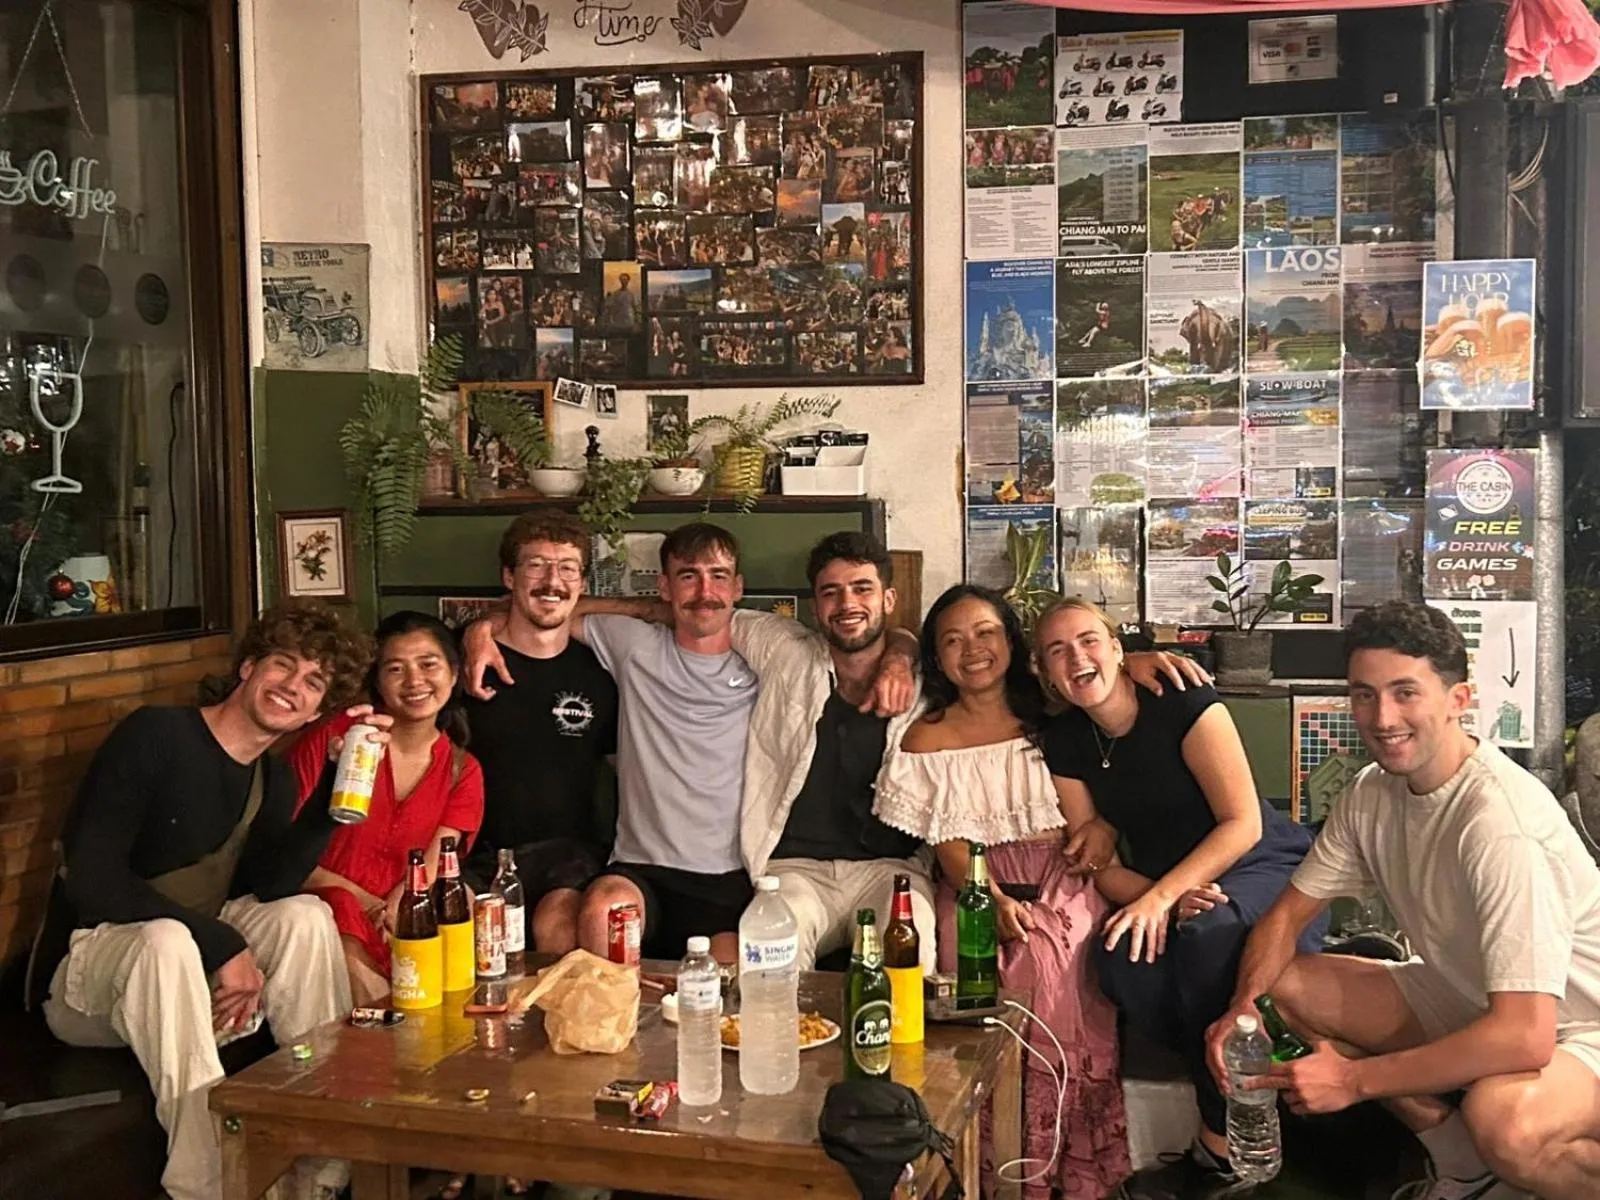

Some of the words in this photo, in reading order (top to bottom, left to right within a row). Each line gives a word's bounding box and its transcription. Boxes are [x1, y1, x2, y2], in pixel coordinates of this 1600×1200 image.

[28, 149, 117, 219] Coffee
[1059, 226, 1095, 236] CHIANG
[1097, 225, 1115, 235] MAI
[1116, 225, 1129, 234] TO
[1130, 225, 1146, 234] PAI
[1265, 247, 1340, 272] LAOS
[1084, 267, 1105, 275] ABOVE
[1441, 272, 1511, 293] HAPPY
[1458, 481, 1477, 492] THE
[1480, 481, 1512, 492] CABIN
[1454, 521, 1522, 535] FREE
[1449, 541, 1510, 552] DRINK
[1437, 558, 1519, 571] GAMES
